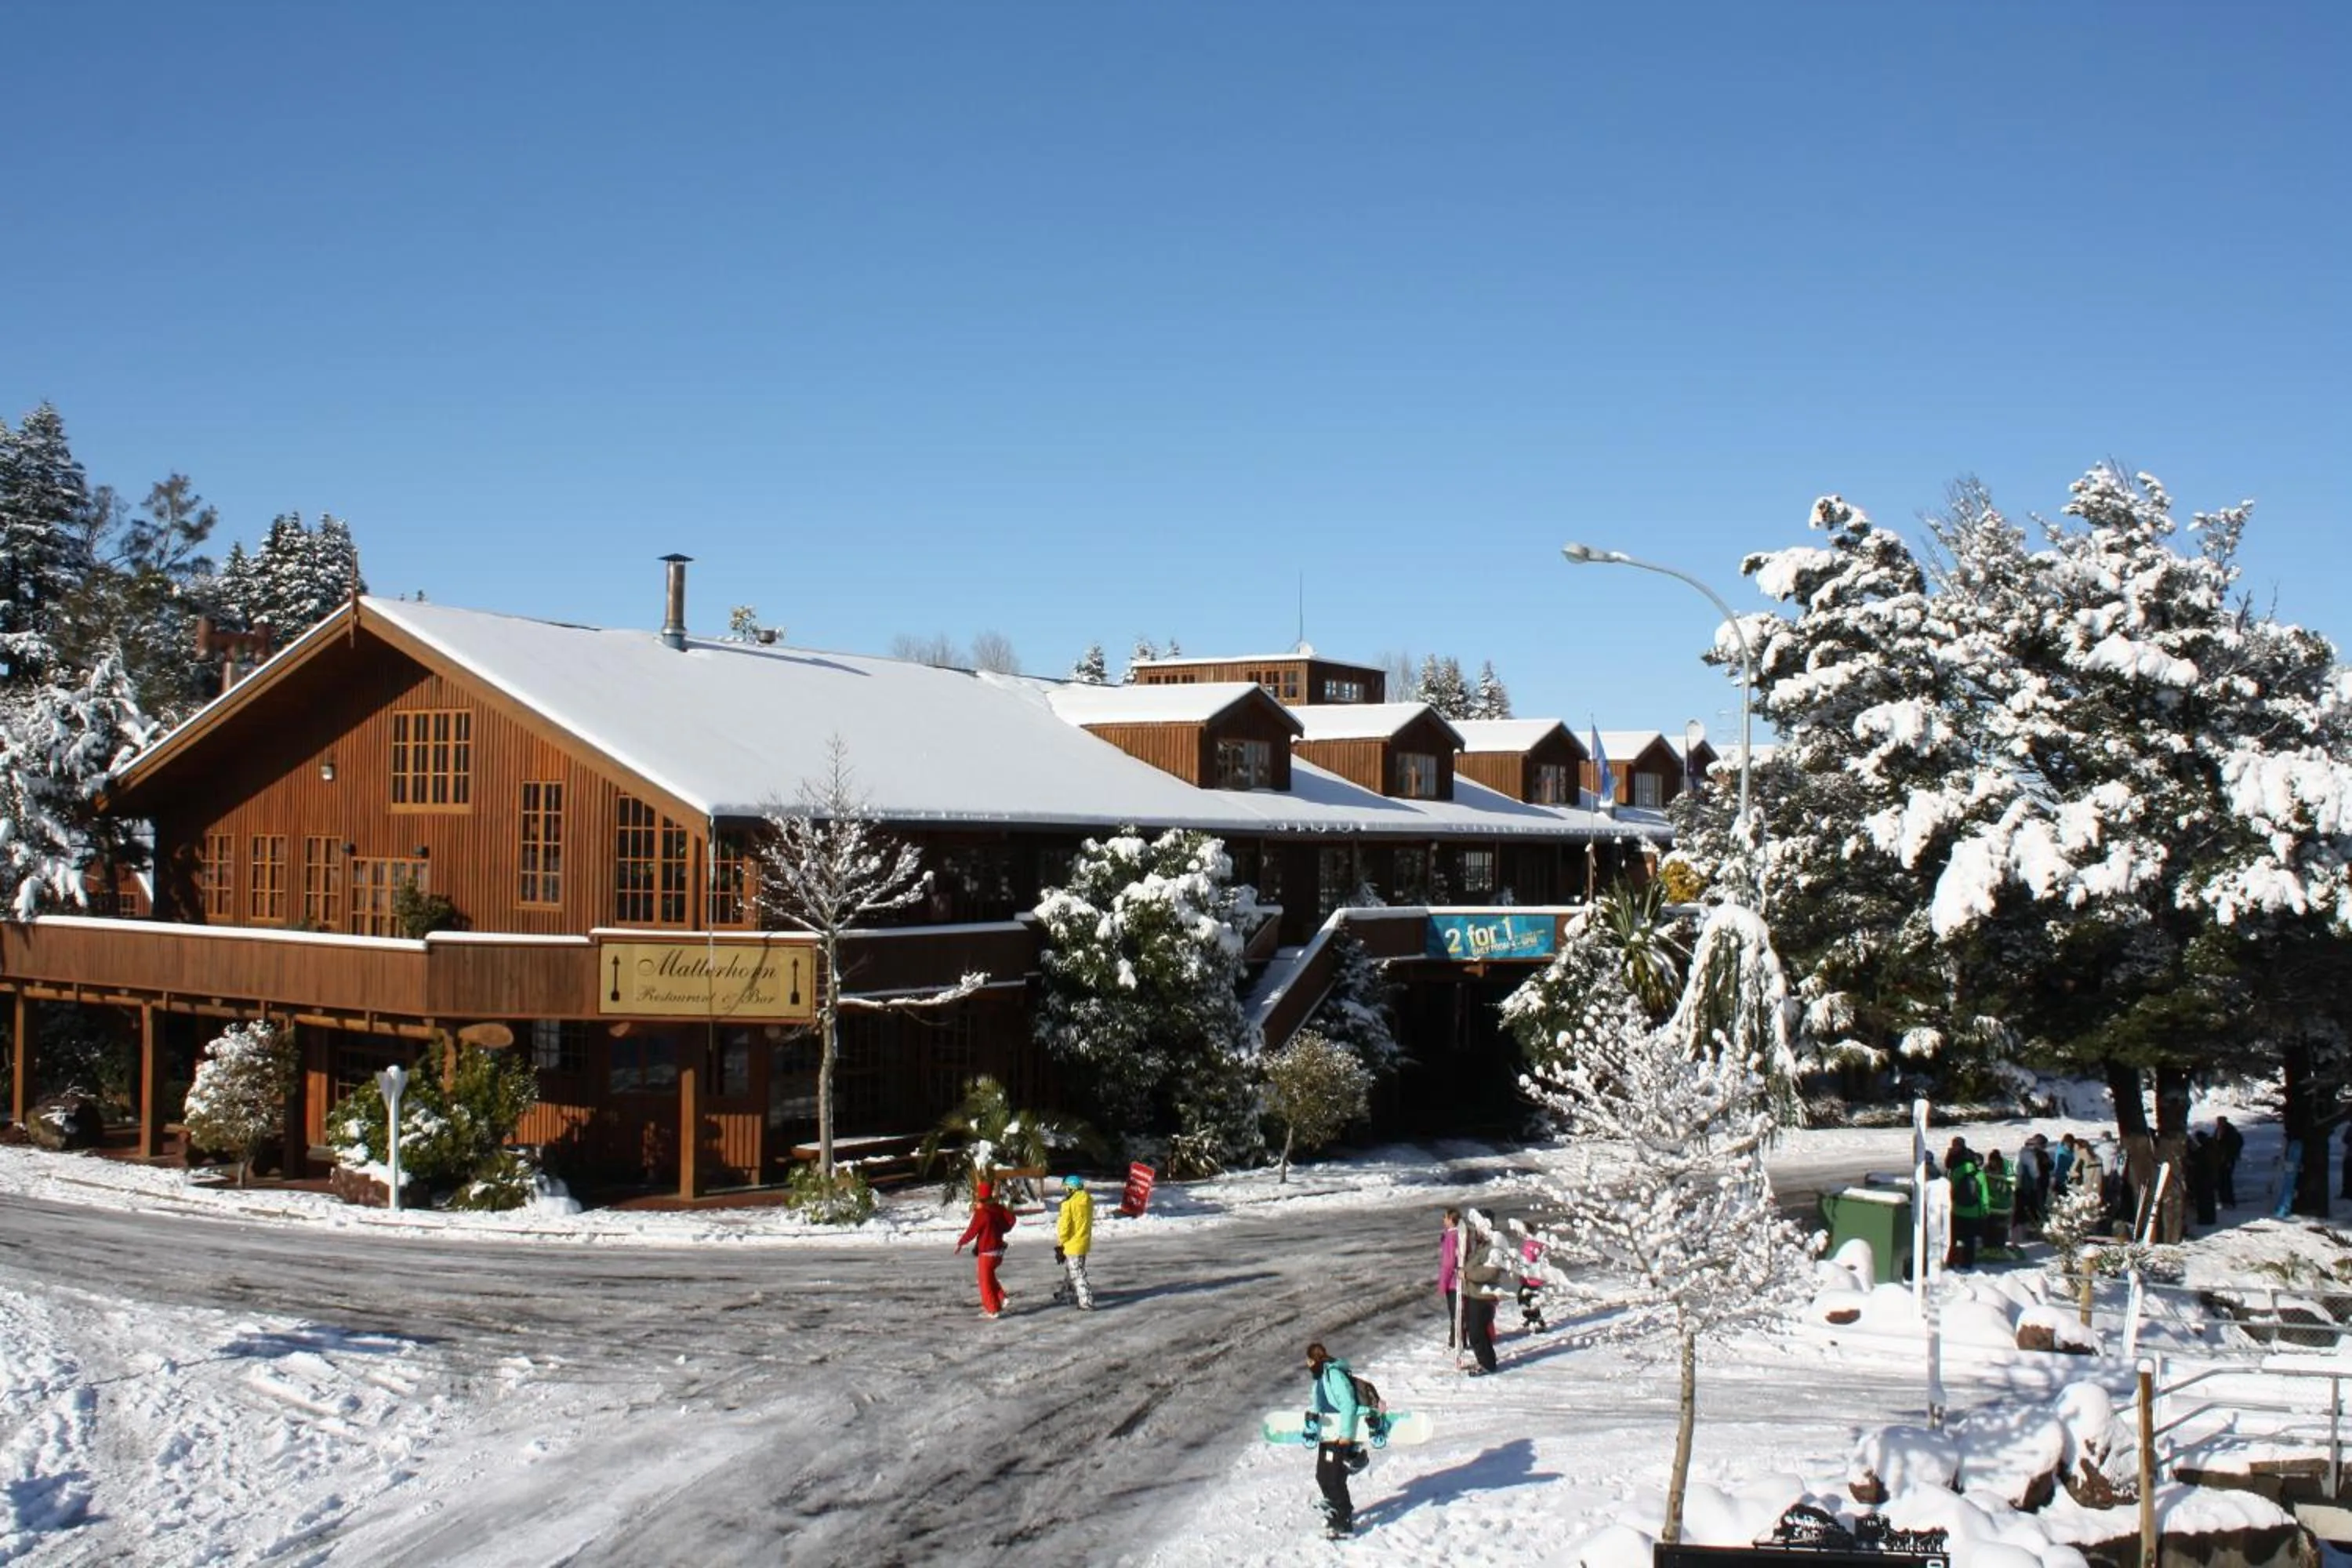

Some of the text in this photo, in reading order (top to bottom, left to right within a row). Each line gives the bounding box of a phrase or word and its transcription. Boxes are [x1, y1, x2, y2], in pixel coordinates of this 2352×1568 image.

[1445, 927, 1462, 953] 2
[1467, 924, 1497, 947] for
[1502, 916, 1512, 943] 1
[637, 948, 777, 979] Matterhorn
[637, 985, 716, 1004] Restaurant
[740, 989, 776, 1004] Bar
